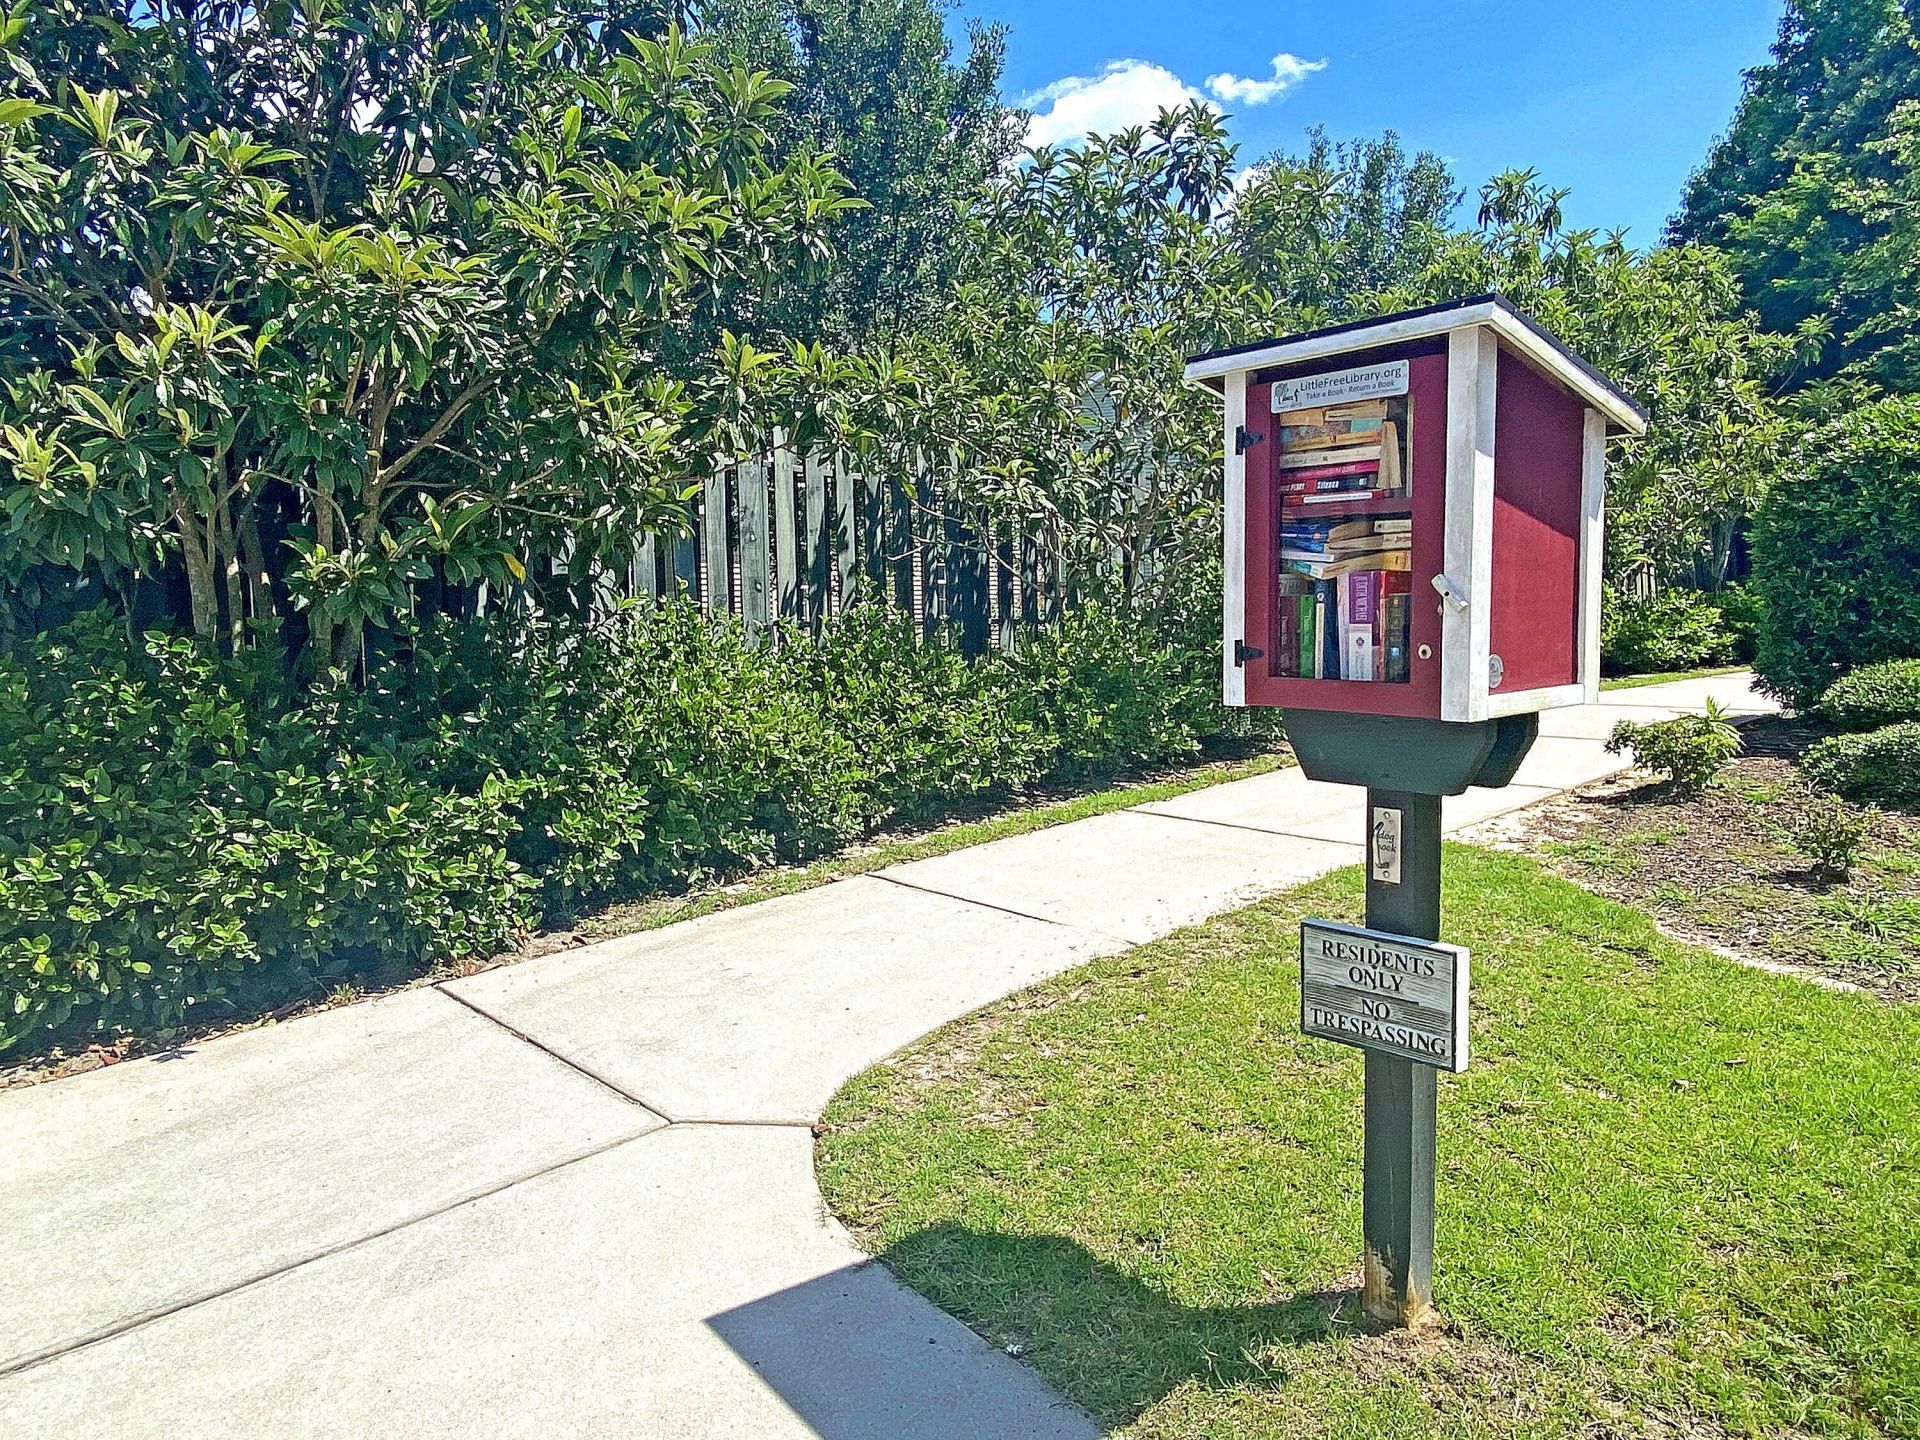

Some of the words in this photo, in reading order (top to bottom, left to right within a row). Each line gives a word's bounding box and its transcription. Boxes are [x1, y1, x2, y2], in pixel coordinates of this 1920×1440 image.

[1306, 388, 1321, 400] Take
[1327, 386, 1344, 397] Book
[1348, 381, 1371, 393] Return
[1377, 380, 1395, 389] Book
[1378, 831, 1395, 844] dog
[1322, 939, 1435, 977] RESIDENTS
[1349, 966, 1404, 992] ONLY
[1361, 999, 1391, 1021] NO
[1310, 1007, 1447, 1056] TRESPASSING
